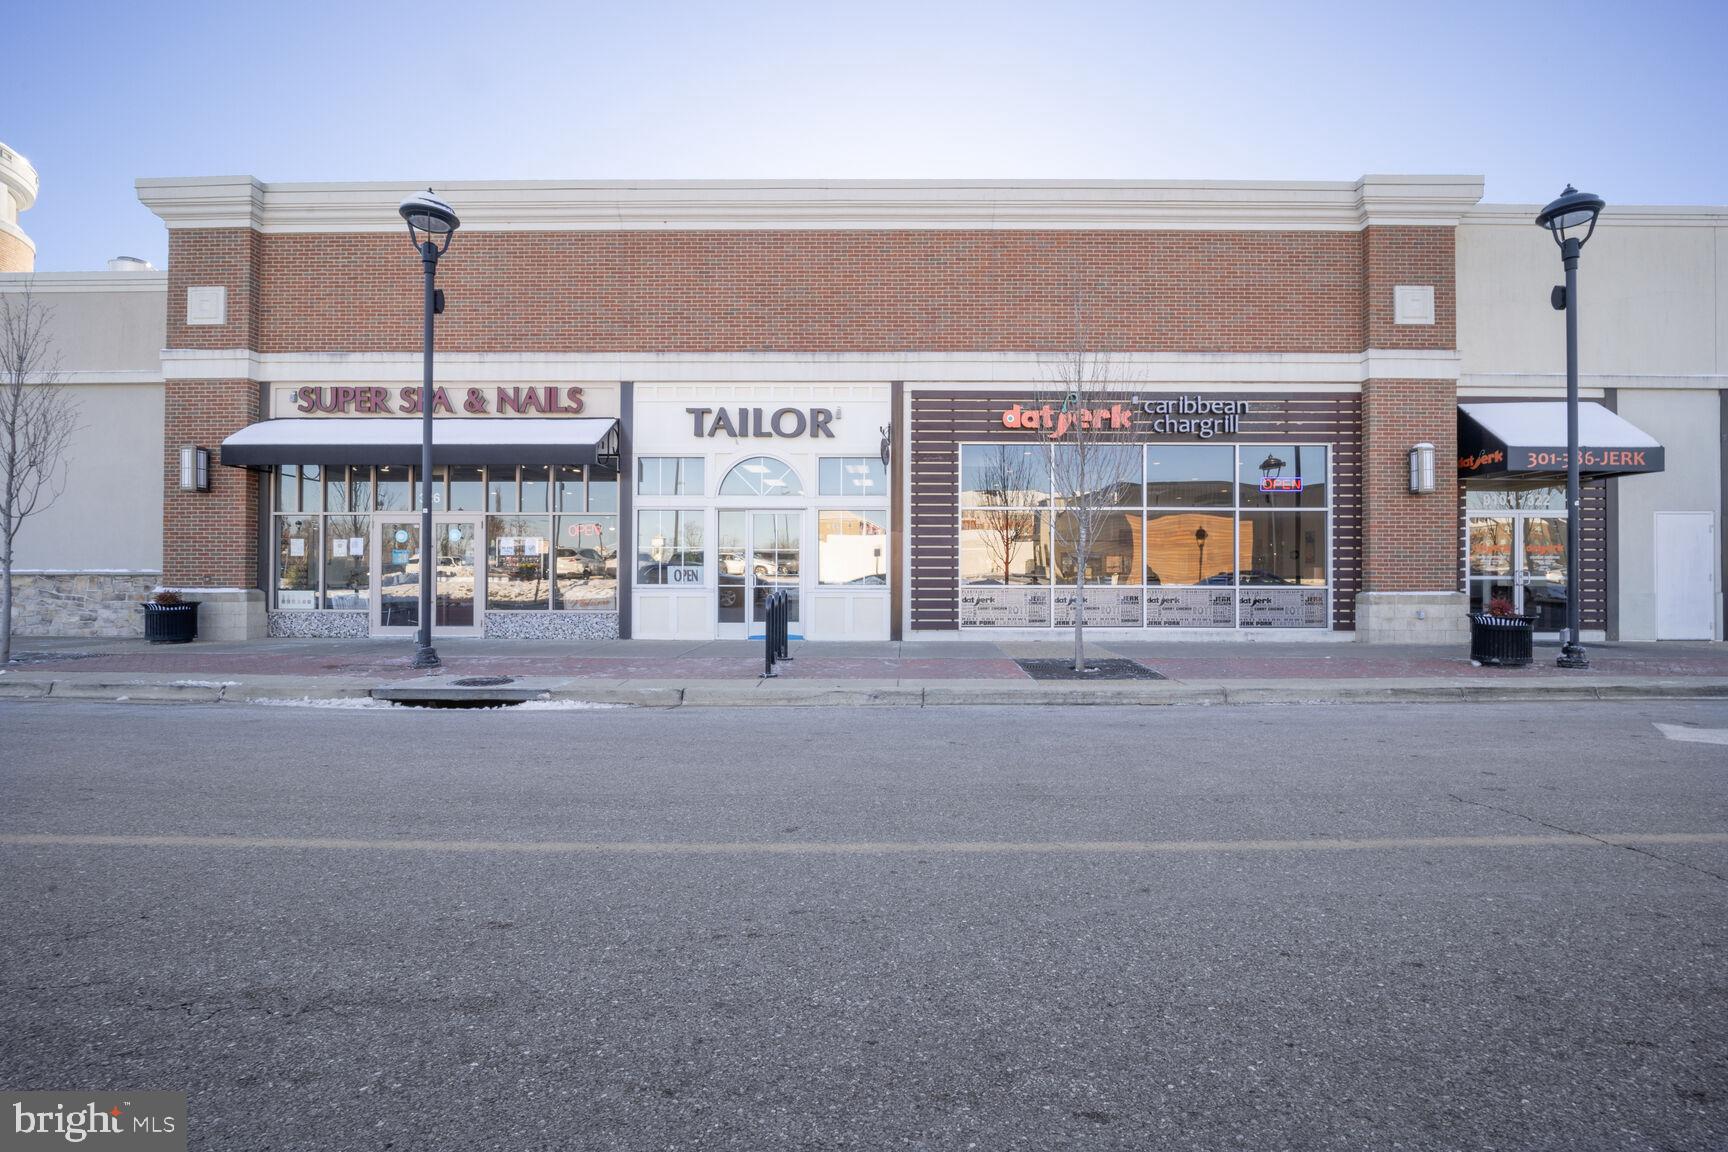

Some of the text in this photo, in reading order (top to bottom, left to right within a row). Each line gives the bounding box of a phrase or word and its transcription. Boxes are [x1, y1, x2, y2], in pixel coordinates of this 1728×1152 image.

[297, 385, 394, 414] SUPER
[463, 386, 489, 414] &
[496, 385, 585, 414] NAILS
[1143, 395, 1250, 414] caribbean
[685, 406, 836, 438] TAILOR
[1153, 414, 1240, 439] chargrill
[1262, 478, 1301, 490] OPEN
[568, 523, 603, 537] OPEN
[673, 569, 699, 582] OPEN
